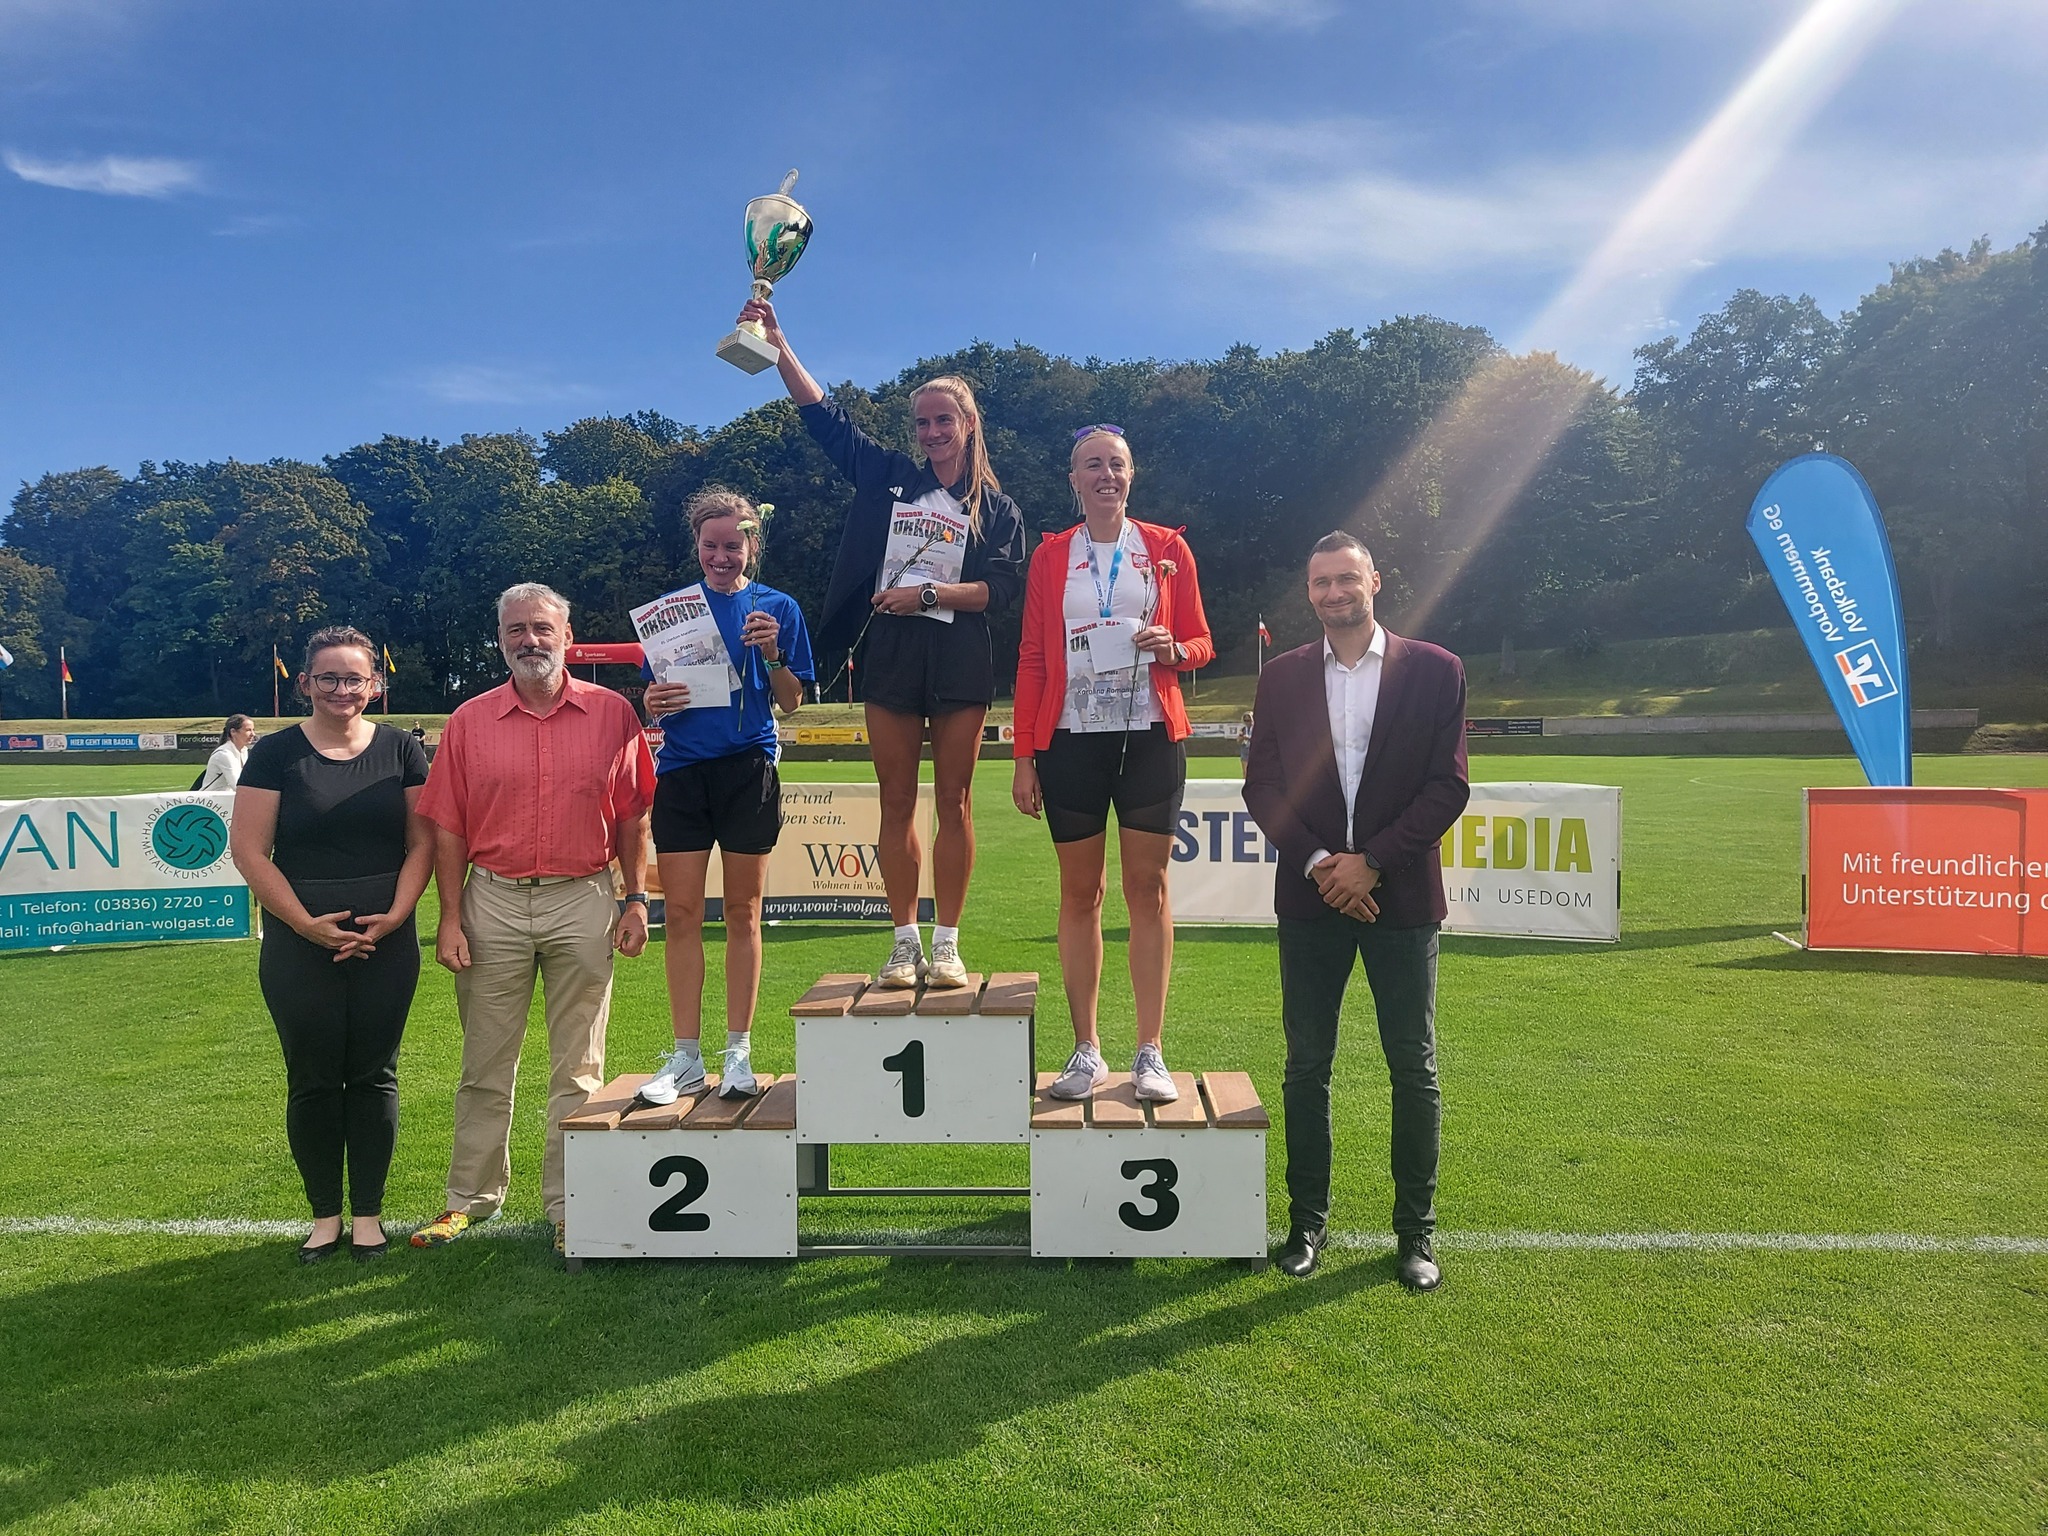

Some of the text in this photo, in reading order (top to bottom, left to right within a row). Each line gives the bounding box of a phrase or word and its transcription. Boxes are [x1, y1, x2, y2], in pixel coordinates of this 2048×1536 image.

[931, 512, 965, 530] MARATHON
[920, 558, 934, 566] Platz
[636, 605, 660, 623] USEDOM
[665, 594, 701, 605] MARATHON
[639, 602, 710, 640] URKUNDE
[680, 643, 693, 652] Platz
[70, 738, 84, 746] HIER
[85, 738, 100, 746] GEHT
[803, 790, 833, 804] und
[142, 798, 182, 835] HADRIAN
[812, 810, 846, 825] sein.
[142, 841, 233, 879] METALL-KUNSTSTO
[1843, 853, 1882, 874] Mit
[812, 880, 850, 890] Wohnen
[853, 881, 863, 890] in
[20, 900, 87, 915] Telefon:
[94, 896, 157, 913] (03836)
[163, 895, 203, 909] 2720
[224, 894, 233, 907] 0
[1498, 888, 1592, 908] USEDOM
[1843, 883, 2030, 915] Unterstützung
[37, 915, 235, 936] info@hadrian-wolgast.de
[882, 1040, 926, 1118] 1
[648, 1155, 711, 1234] 2
[1118, 1158, 1180, 1232] 3
